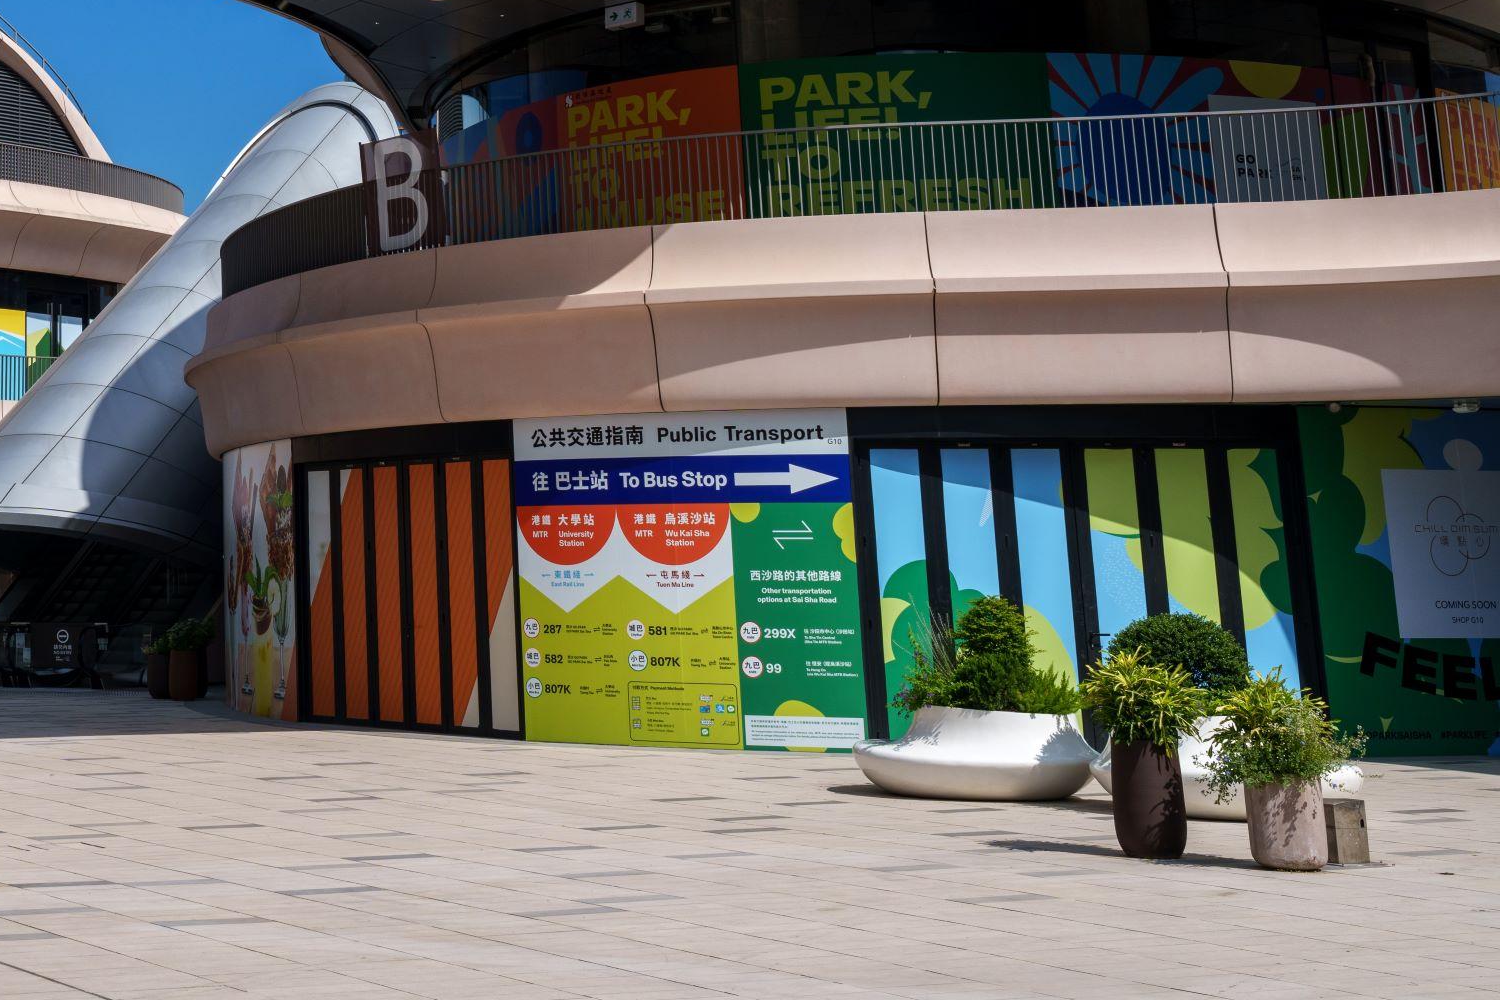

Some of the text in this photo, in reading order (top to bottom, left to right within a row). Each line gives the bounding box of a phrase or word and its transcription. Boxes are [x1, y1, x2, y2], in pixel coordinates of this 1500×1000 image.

[759, 69, 933, 110] PARK,
[567, 88, 692, 138] PARK,
[762, 106, 899, 146] LIFE!
[762, 145, 840, 182] TO
[1236, 154, 1256, 164] GO
[374, 137, 429, 252] B
[766, 177, 1033, 218] REFRESH
[531, 425, 824, 448] 公共交通指南 Public Transport
[532, 470, 728, 492] 往 巴士站 To Bus Stop
[558, 513, 594, 526] 大學站
[680, 529, 692, 537] Kai
[694, 529, 710, 537] Sha
[1414, 524, 1447, 533] CHILL
[1450, 524, 1471, 533] DIM
[532, 530, 594, 539] MTR University
[665, 539, 694, 547] Station
[757, 596, 783, 604] options
[1435, 600, 1497, 609] COMING SOON
[1452, 616, 1470, 624] SHOP
[526, 623, 538, 631] 九巴
[544, 624, 562, 634] 287
[648, 626, 667, 636] 581
[743, 627, 758, 635] 九巴
[764, 628, 796, 639] 299X
[545, 654, 563, 664] 582
[650, 657, 680, 667] 807K
[744, 661, 760, 669] 九巴
[766, 663, 782, 674] 99
[1359, 631, 1500, 702] FEEL
[545, 684, 571, 694] 807K
